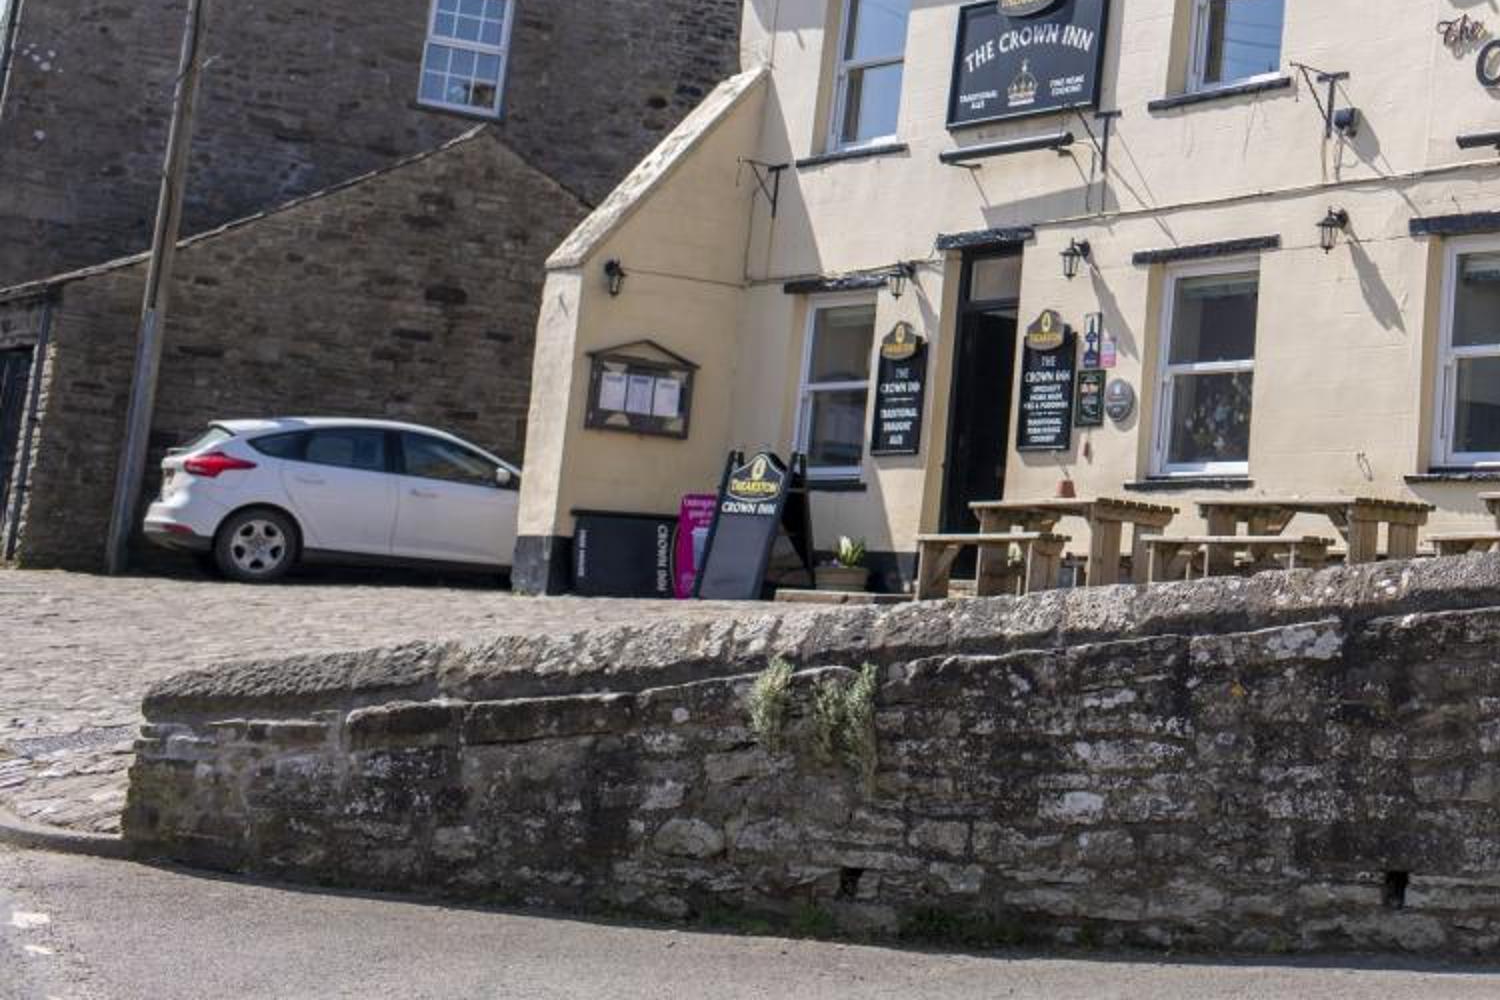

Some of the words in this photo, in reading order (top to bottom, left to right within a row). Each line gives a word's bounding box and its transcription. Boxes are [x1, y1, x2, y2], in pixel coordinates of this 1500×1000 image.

[965, 40, 995, 72] THE
[999, 23, 1059, 53] CROWN
[1061, 24, 1094, 51] INN
[1437, 14, 1485, 57] The
[1025, 371, 1054, 383] CROWN
[722, 501, 757, 514] CROWN
